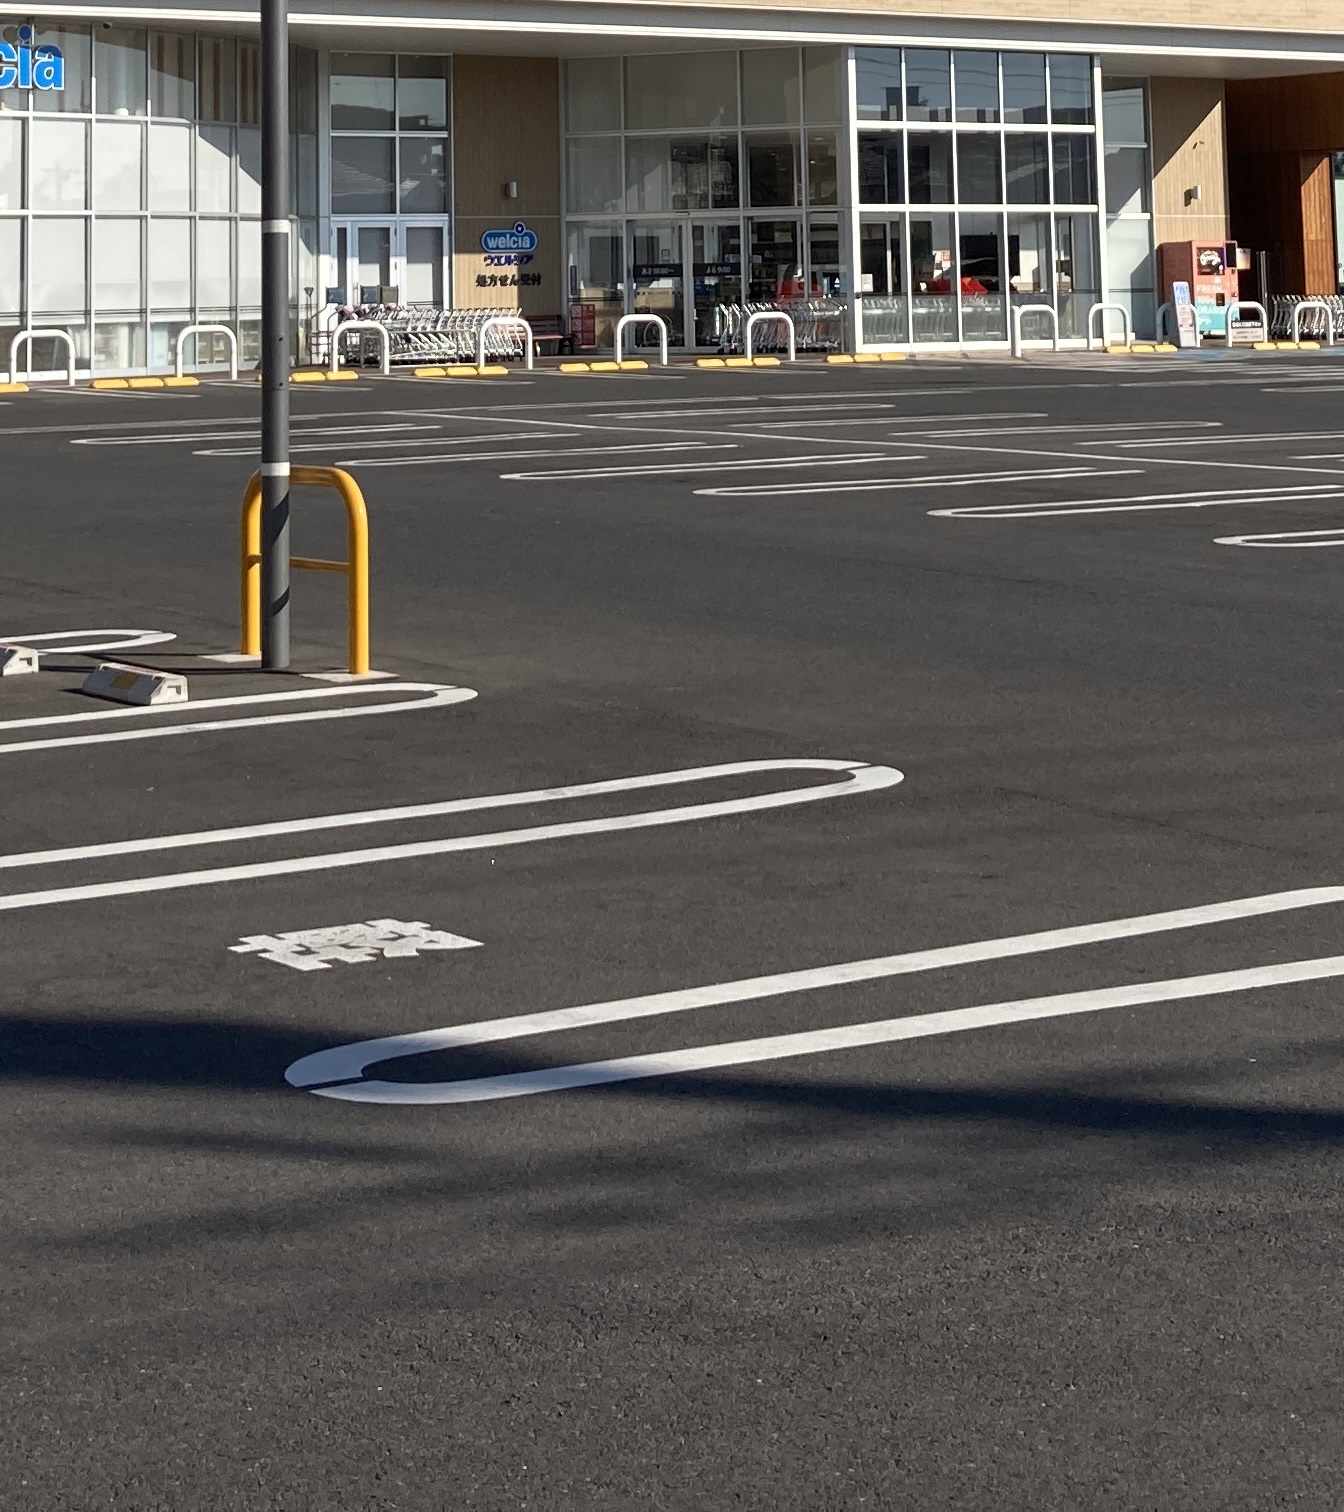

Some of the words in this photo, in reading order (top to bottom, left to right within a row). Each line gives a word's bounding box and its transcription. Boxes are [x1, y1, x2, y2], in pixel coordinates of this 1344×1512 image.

[486, 229, 532, 250] welcia
[476, 273, 542, 287] 処方せん受付
